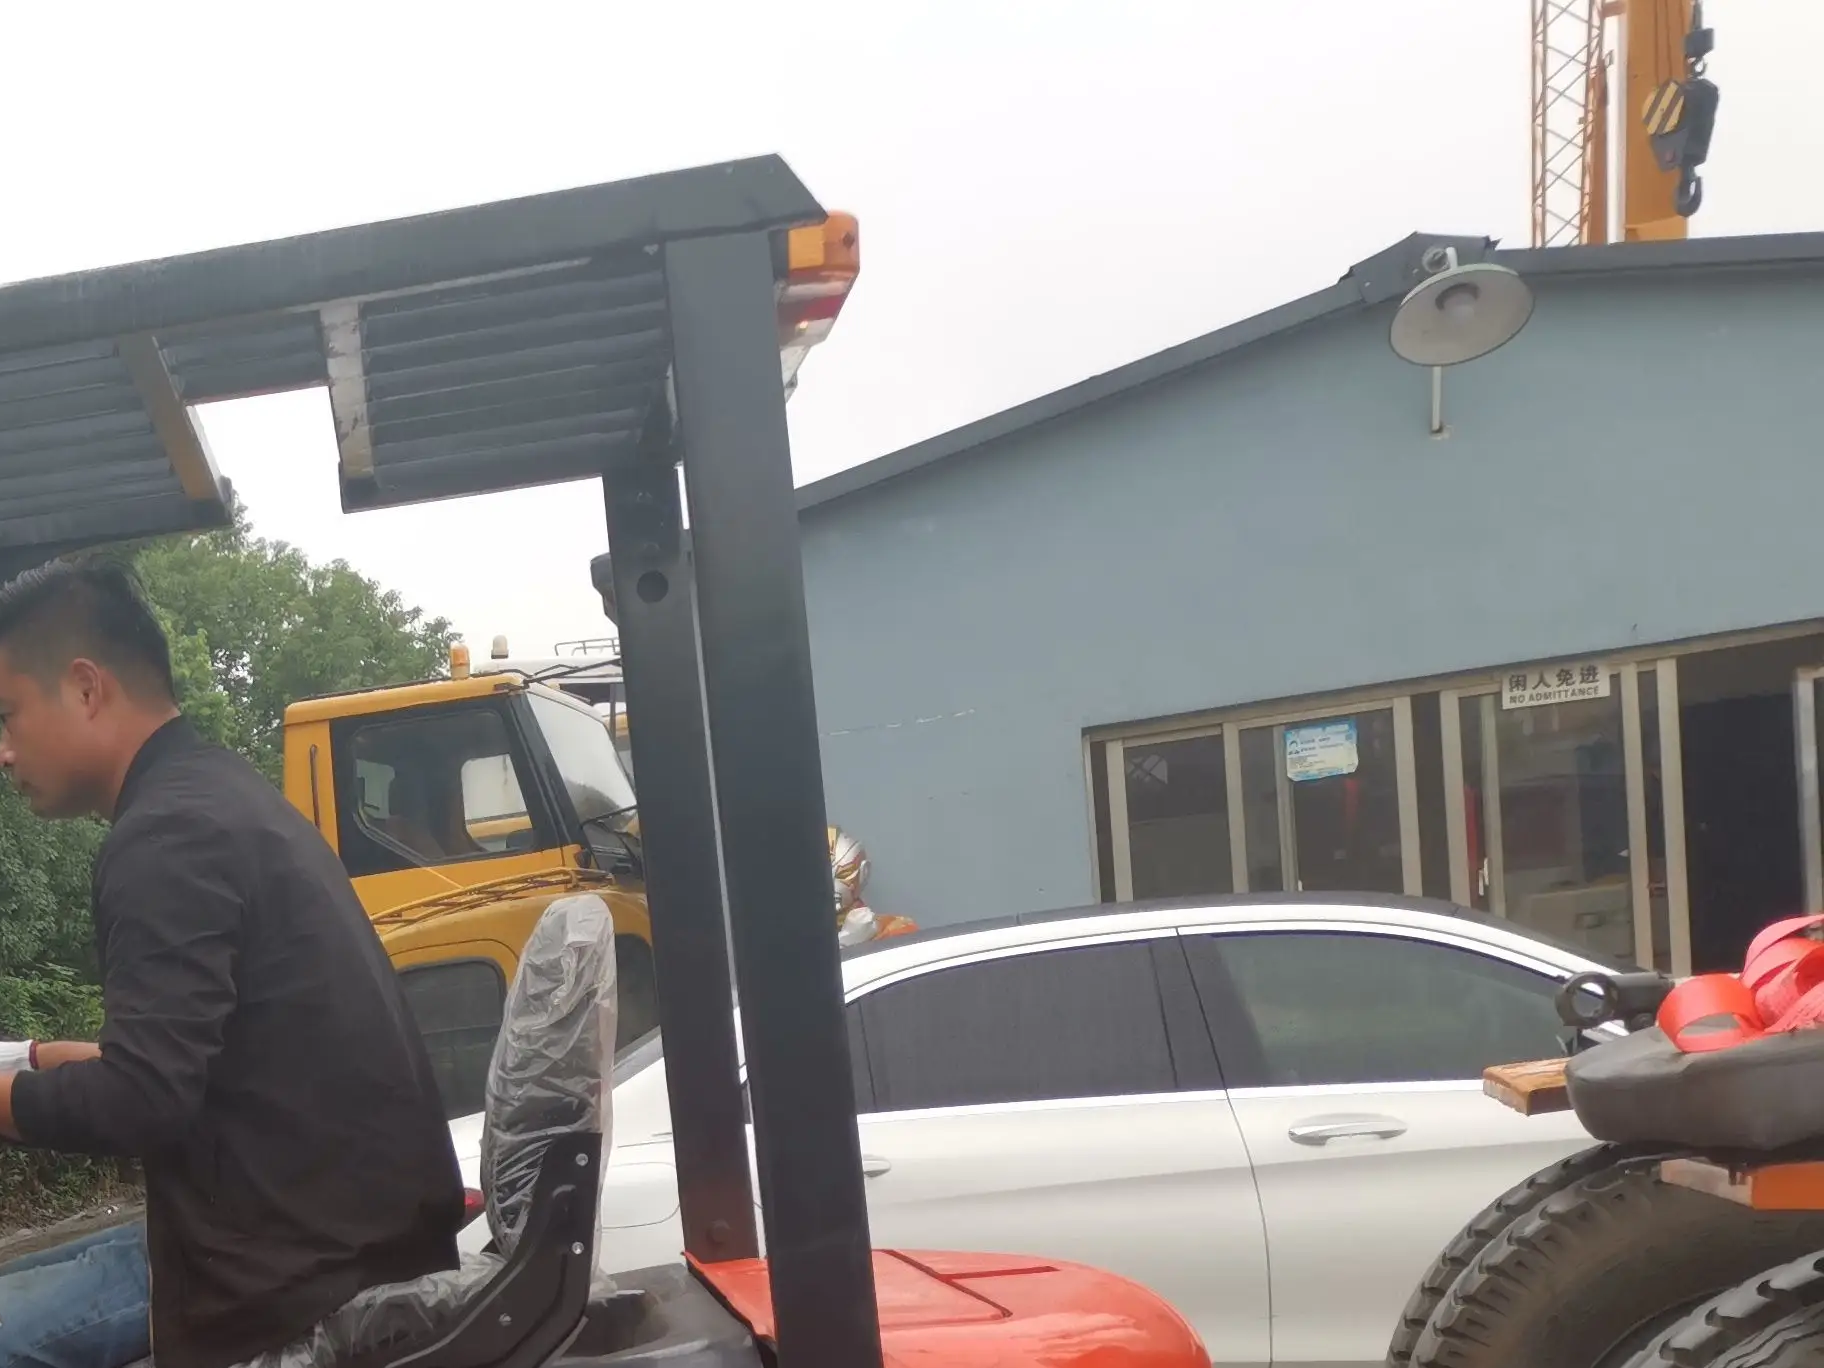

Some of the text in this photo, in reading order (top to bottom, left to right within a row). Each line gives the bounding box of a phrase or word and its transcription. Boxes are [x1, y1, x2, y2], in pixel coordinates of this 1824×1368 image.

[1509, 664, 1600, 692] 闲人免进
[1509, 685, 1600, 704] NO ADMITTANCE
